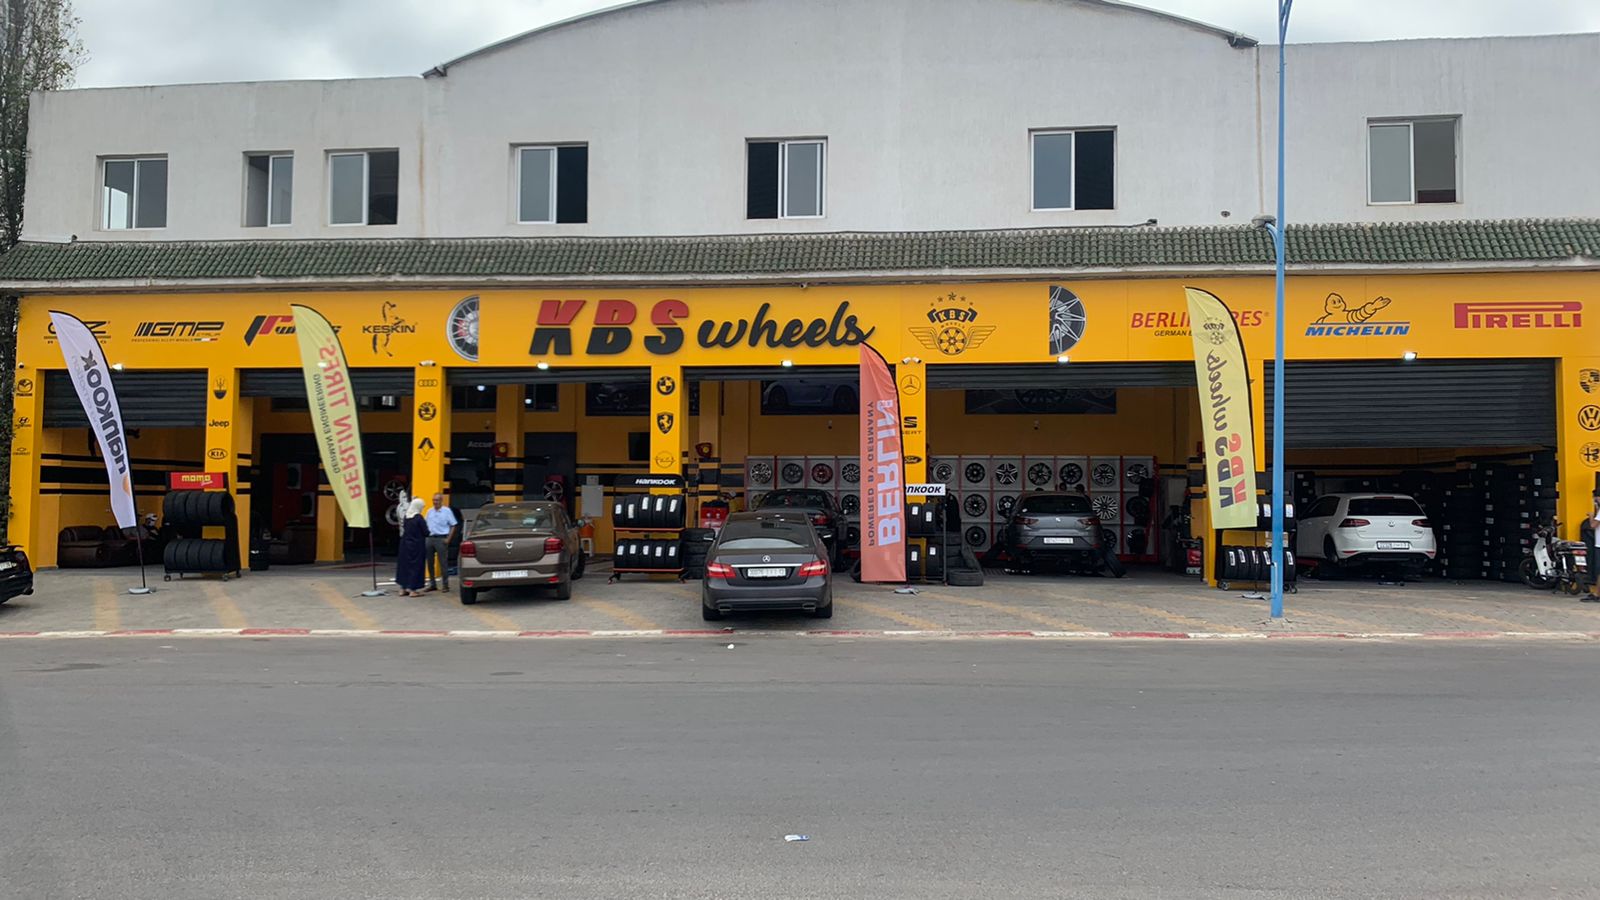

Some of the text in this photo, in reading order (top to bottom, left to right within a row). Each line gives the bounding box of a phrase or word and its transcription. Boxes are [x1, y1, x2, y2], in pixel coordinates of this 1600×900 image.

[1131, 311, 1191, 328] BERLI
[1454, 301, 1583, 329] PIRELLI
[147, 321, 225, 337] GMP
[362, 324, 416, 334] KESKIN
[528, 299, 875, 356] KBS wheels
[1154, 329, 1187, 337] GERMAN
[1305, 325, 1410, 336] MICHELIN
[209, 419, 230, 428] Jeep
[182, 474, 211, 482] momo
